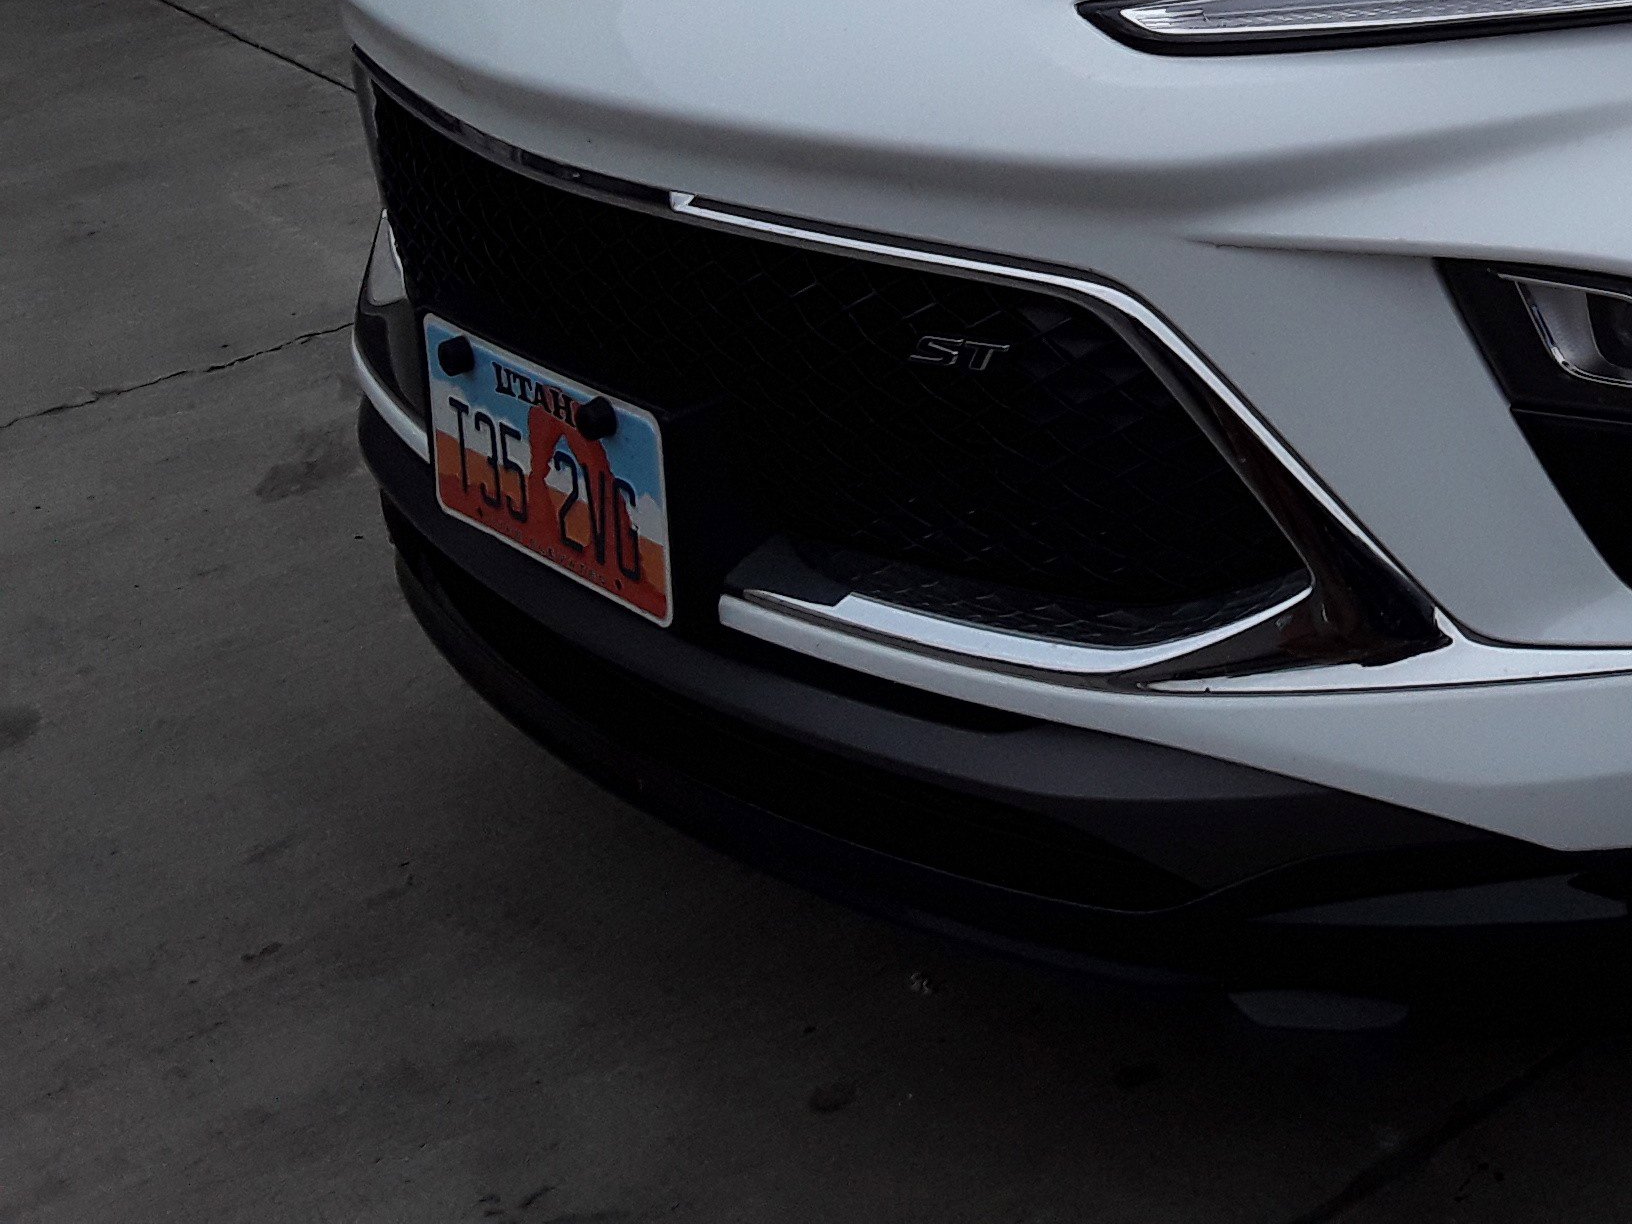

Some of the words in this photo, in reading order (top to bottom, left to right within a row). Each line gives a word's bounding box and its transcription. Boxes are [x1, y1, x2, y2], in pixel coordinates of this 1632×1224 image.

[909, 335, 1010, 371] ST
[492, 362, 577, 427] UTAH
[448, 396, 528, 523] T35
[554, 450, 642, 581] 2VG
